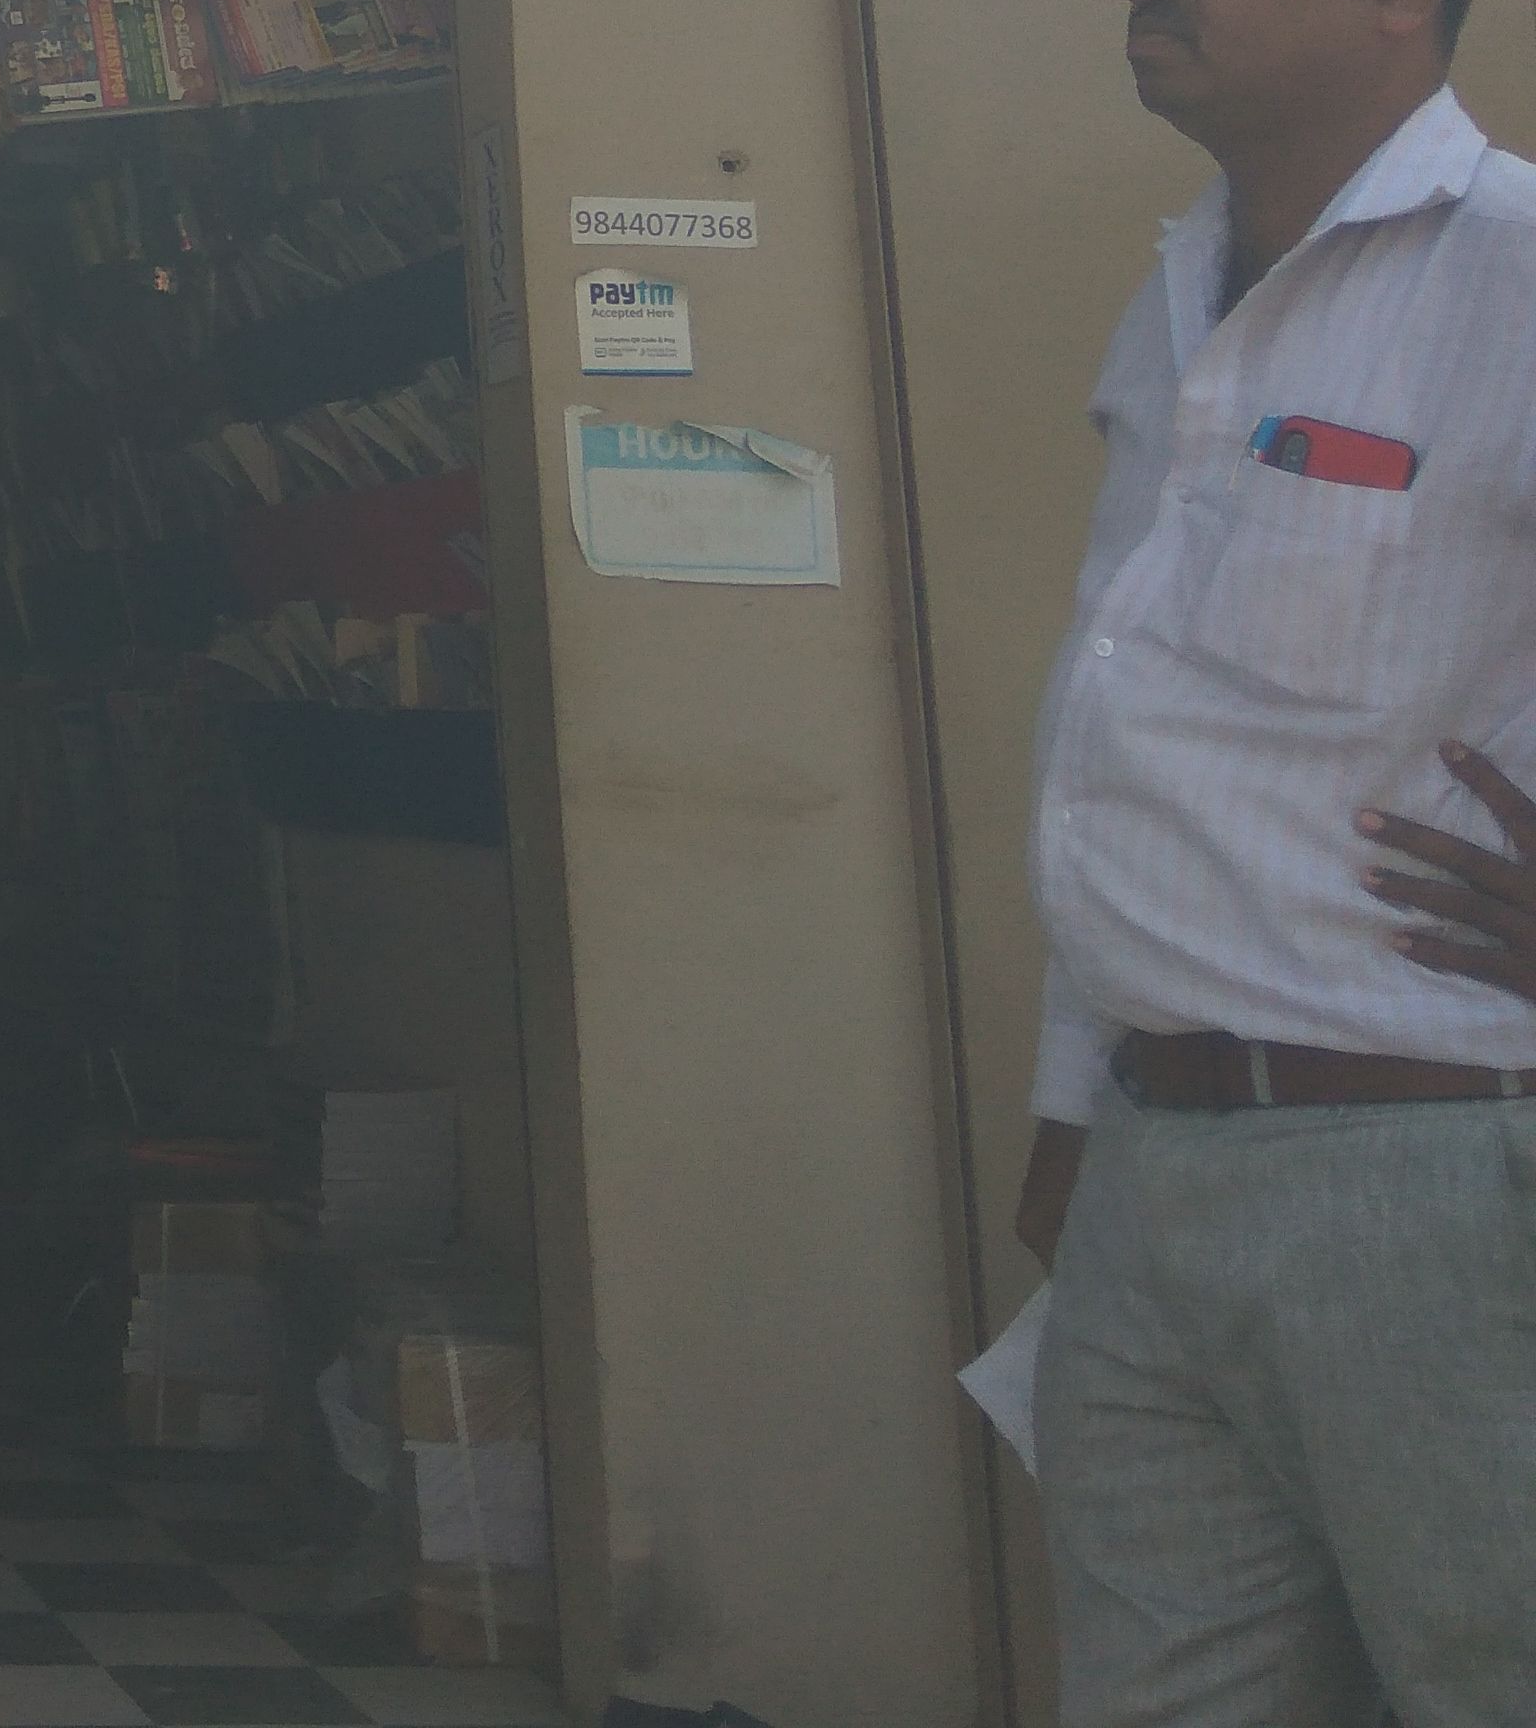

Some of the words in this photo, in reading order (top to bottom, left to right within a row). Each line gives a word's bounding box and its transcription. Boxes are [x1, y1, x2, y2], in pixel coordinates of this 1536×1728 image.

[574, 208, 753, 241] 9844077368
[590, 280, 673, 305] paytm
[592, 309, 643, 319] Accepted
[647, 309, 674, 318] Here
